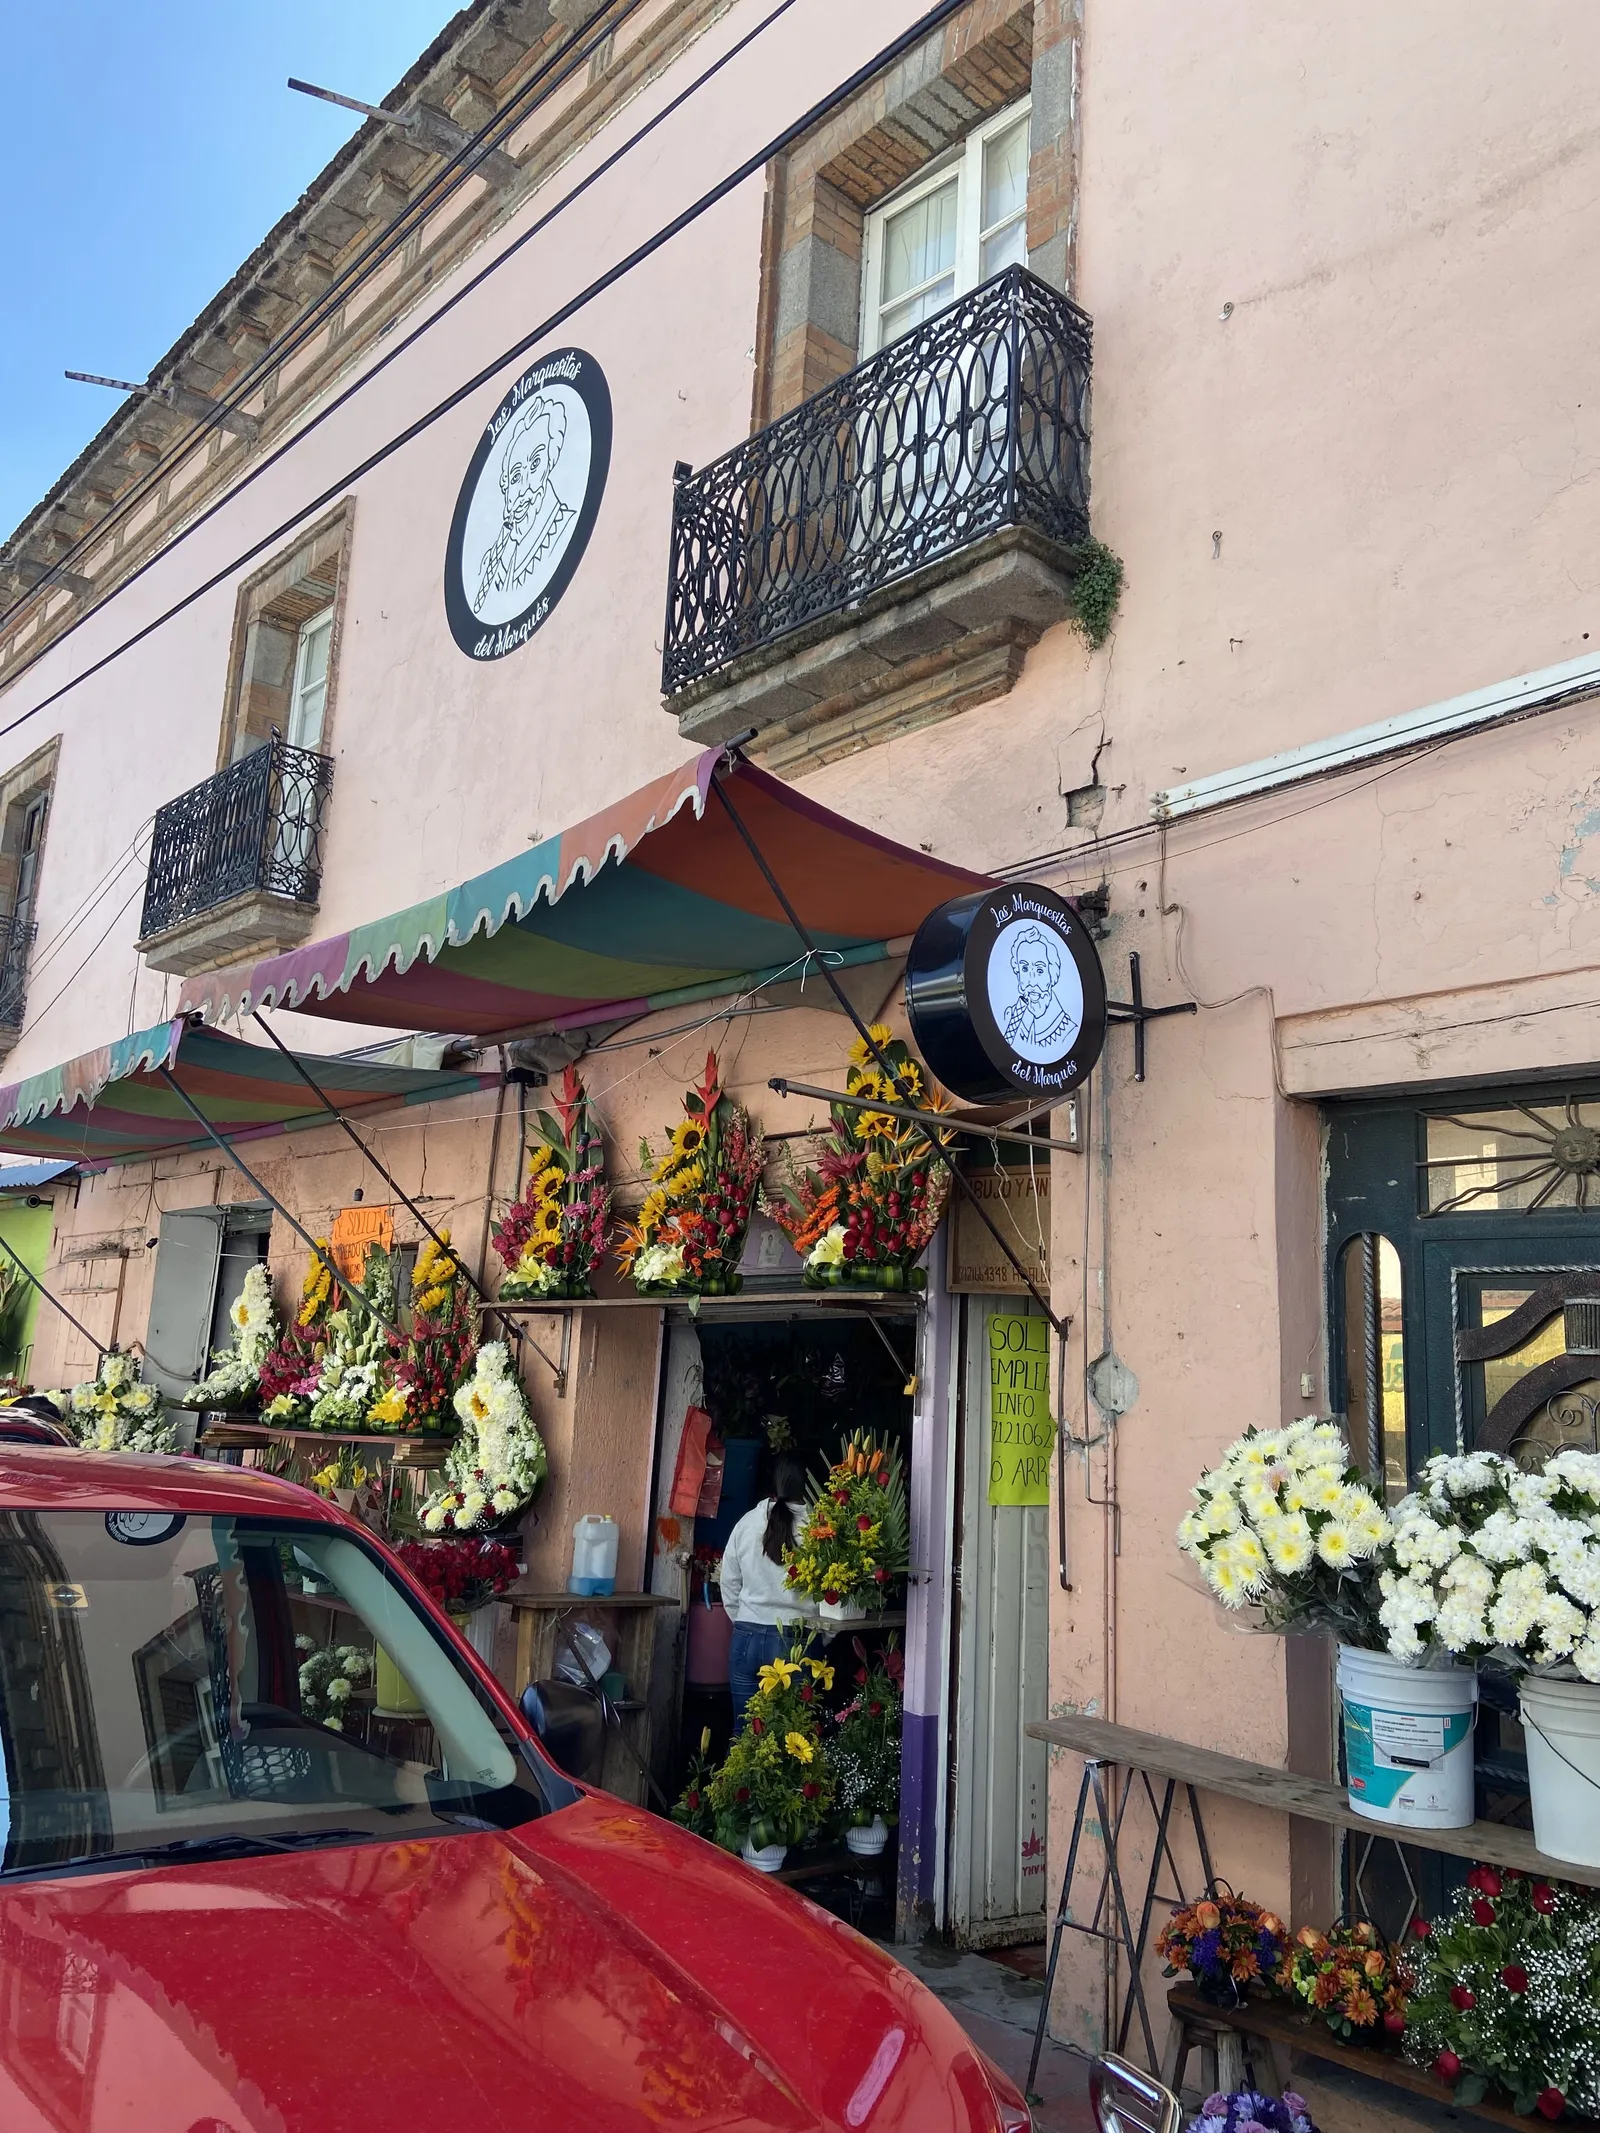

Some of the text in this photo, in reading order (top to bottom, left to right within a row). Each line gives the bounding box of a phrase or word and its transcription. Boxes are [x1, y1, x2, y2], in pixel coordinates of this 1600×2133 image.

[487, 352, 582, 445] Las Marquesitas
[474, 597, 550, 657] del Marqués
[990, 892, 1073, 935] Las Marquesitas
[1011, 1059, 1078, 1089] del Marqués
[1014, 1177, 1025, 1198] Y
[1012, 1455, 1051, 1488] ARR
